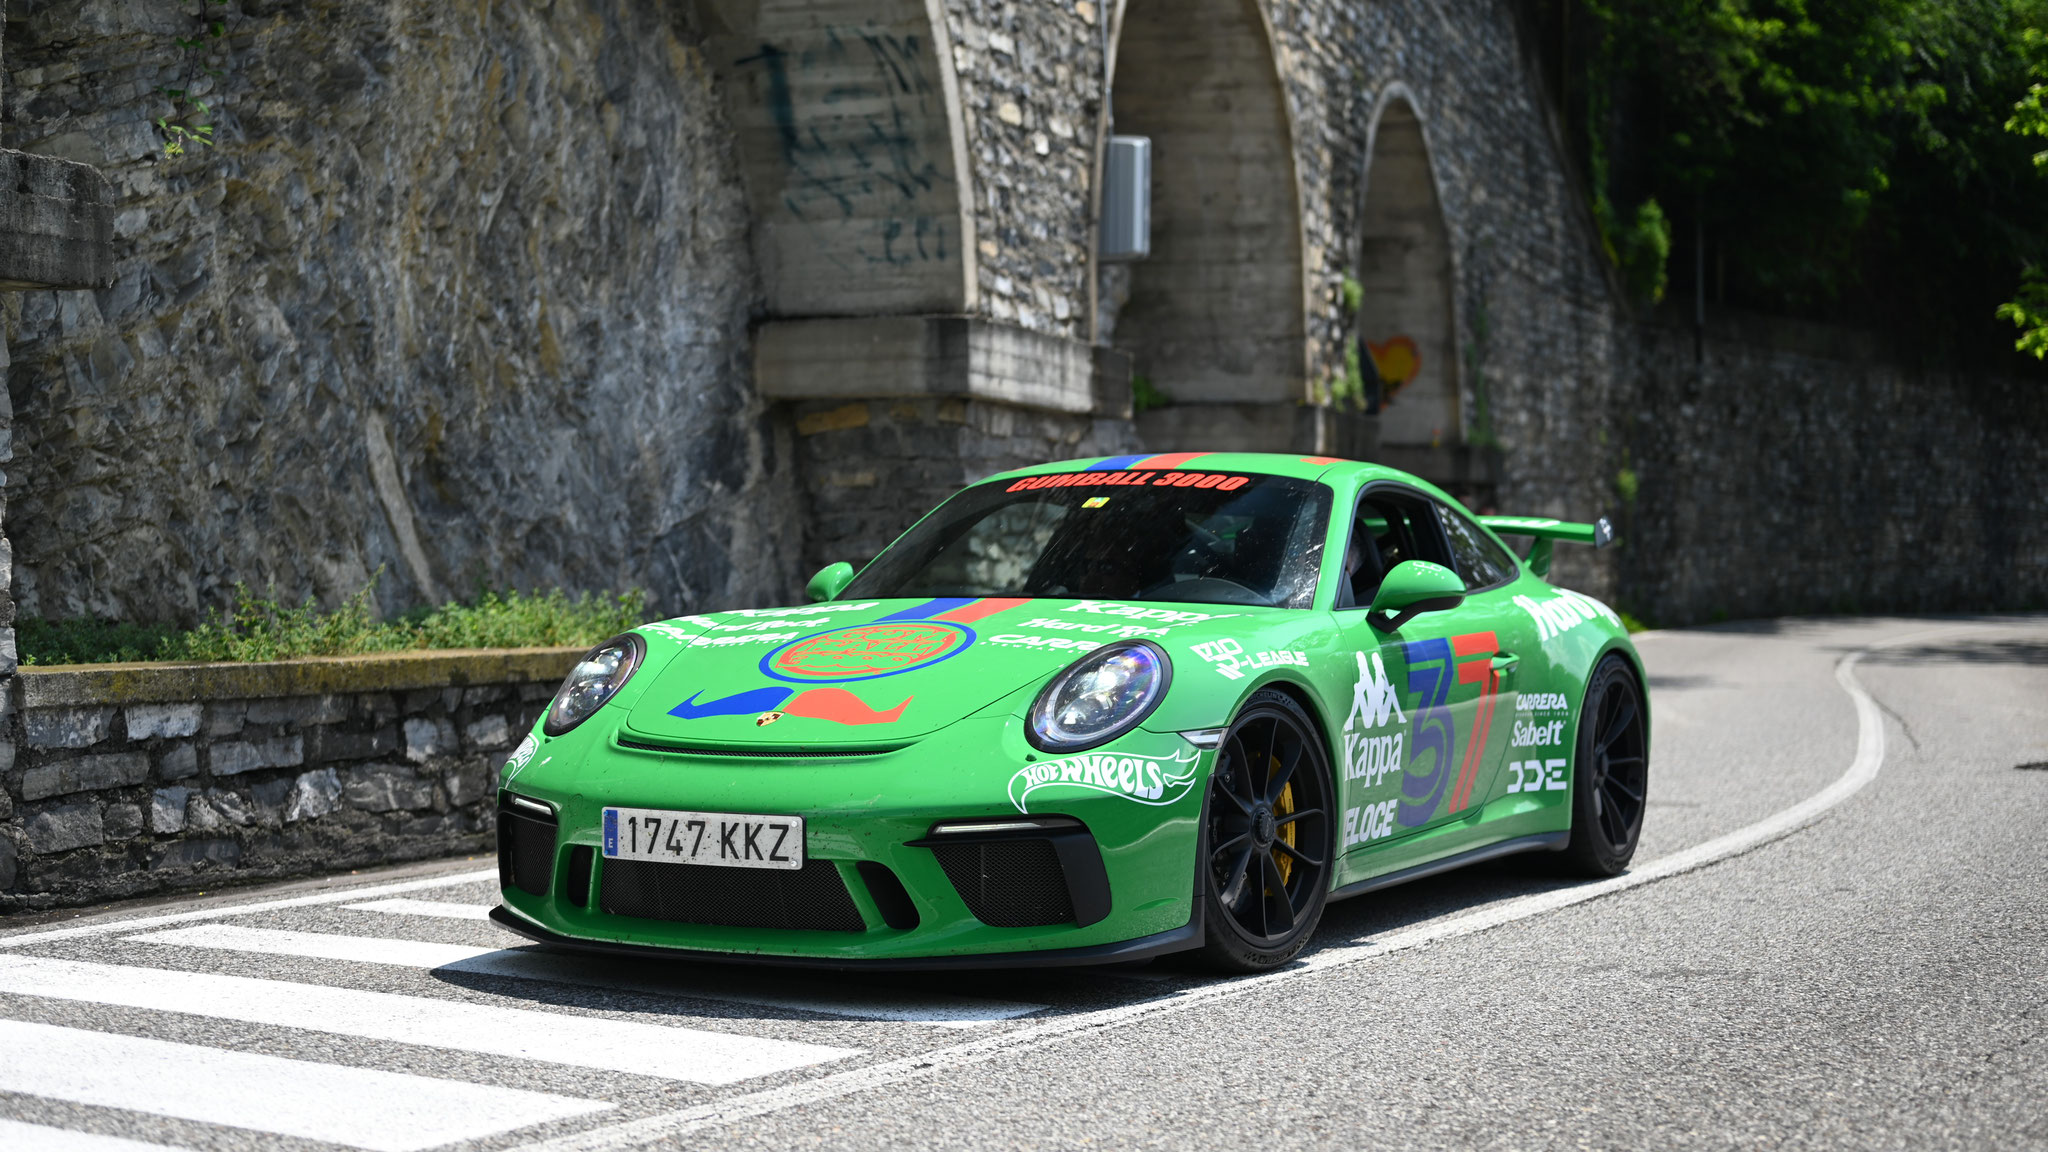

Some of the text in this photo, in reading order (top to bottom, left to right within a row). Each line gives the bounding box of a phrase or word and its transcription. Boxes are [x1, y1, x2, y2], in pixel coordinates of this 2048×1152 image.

[1005, 472, 1249, 493] GUMBALL 3000
[1016, 618, 1120, 633] Hard
[1516, 693, 1568, 711] CARRERA
[1397, 630, 1499, 827] 37
[1512, 720, 1564, 747] Sabelt
[1344, 732, 1403, 788] Kappa
[607, 816, 790, 862] E 1747 KKZ
[1343, 799, 1398, 848] ELOCE
